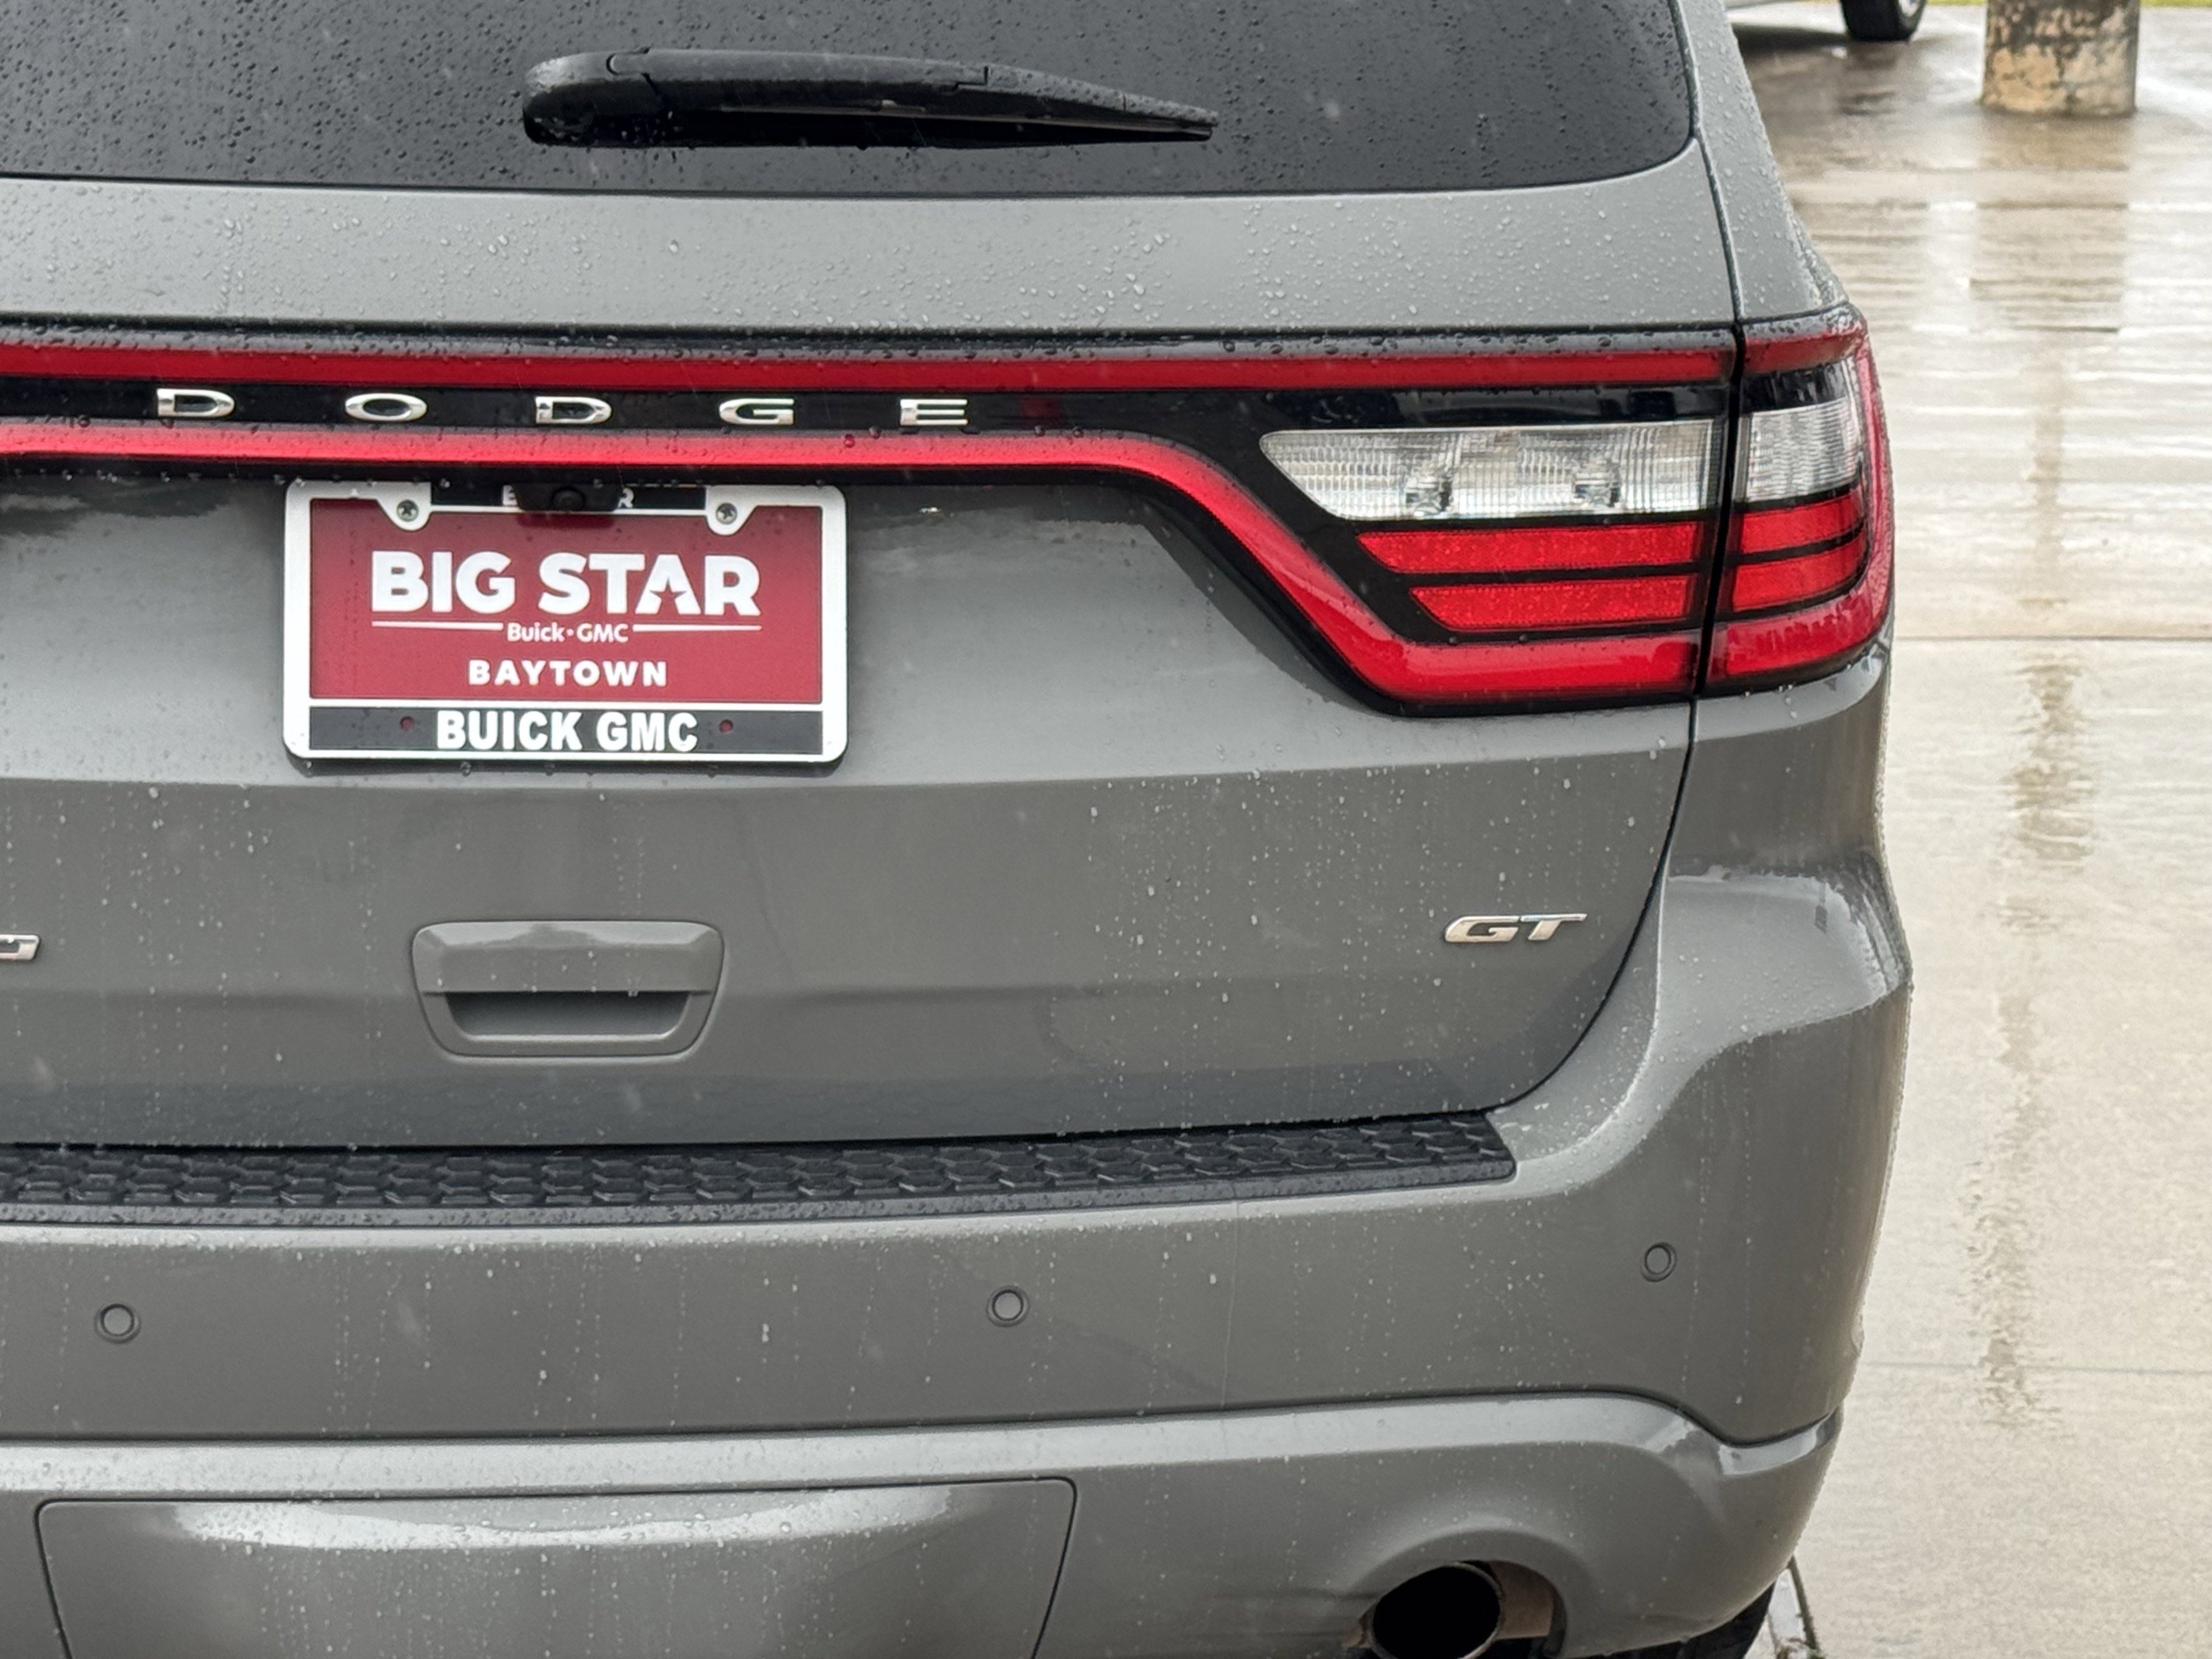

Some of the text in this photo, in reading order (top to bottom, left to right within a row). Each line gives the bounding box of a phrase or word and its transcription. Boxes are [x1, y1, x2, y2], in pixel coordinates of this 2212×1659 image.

[157, 388, 968, 426] DODGE
[371, 551, 761, 617] BIG STAR
[469, 660, 667, 687] BAYTOWN
[438, 711, 698, 753] BUICK GMC
[1445, 913, 1588, 942] GT
